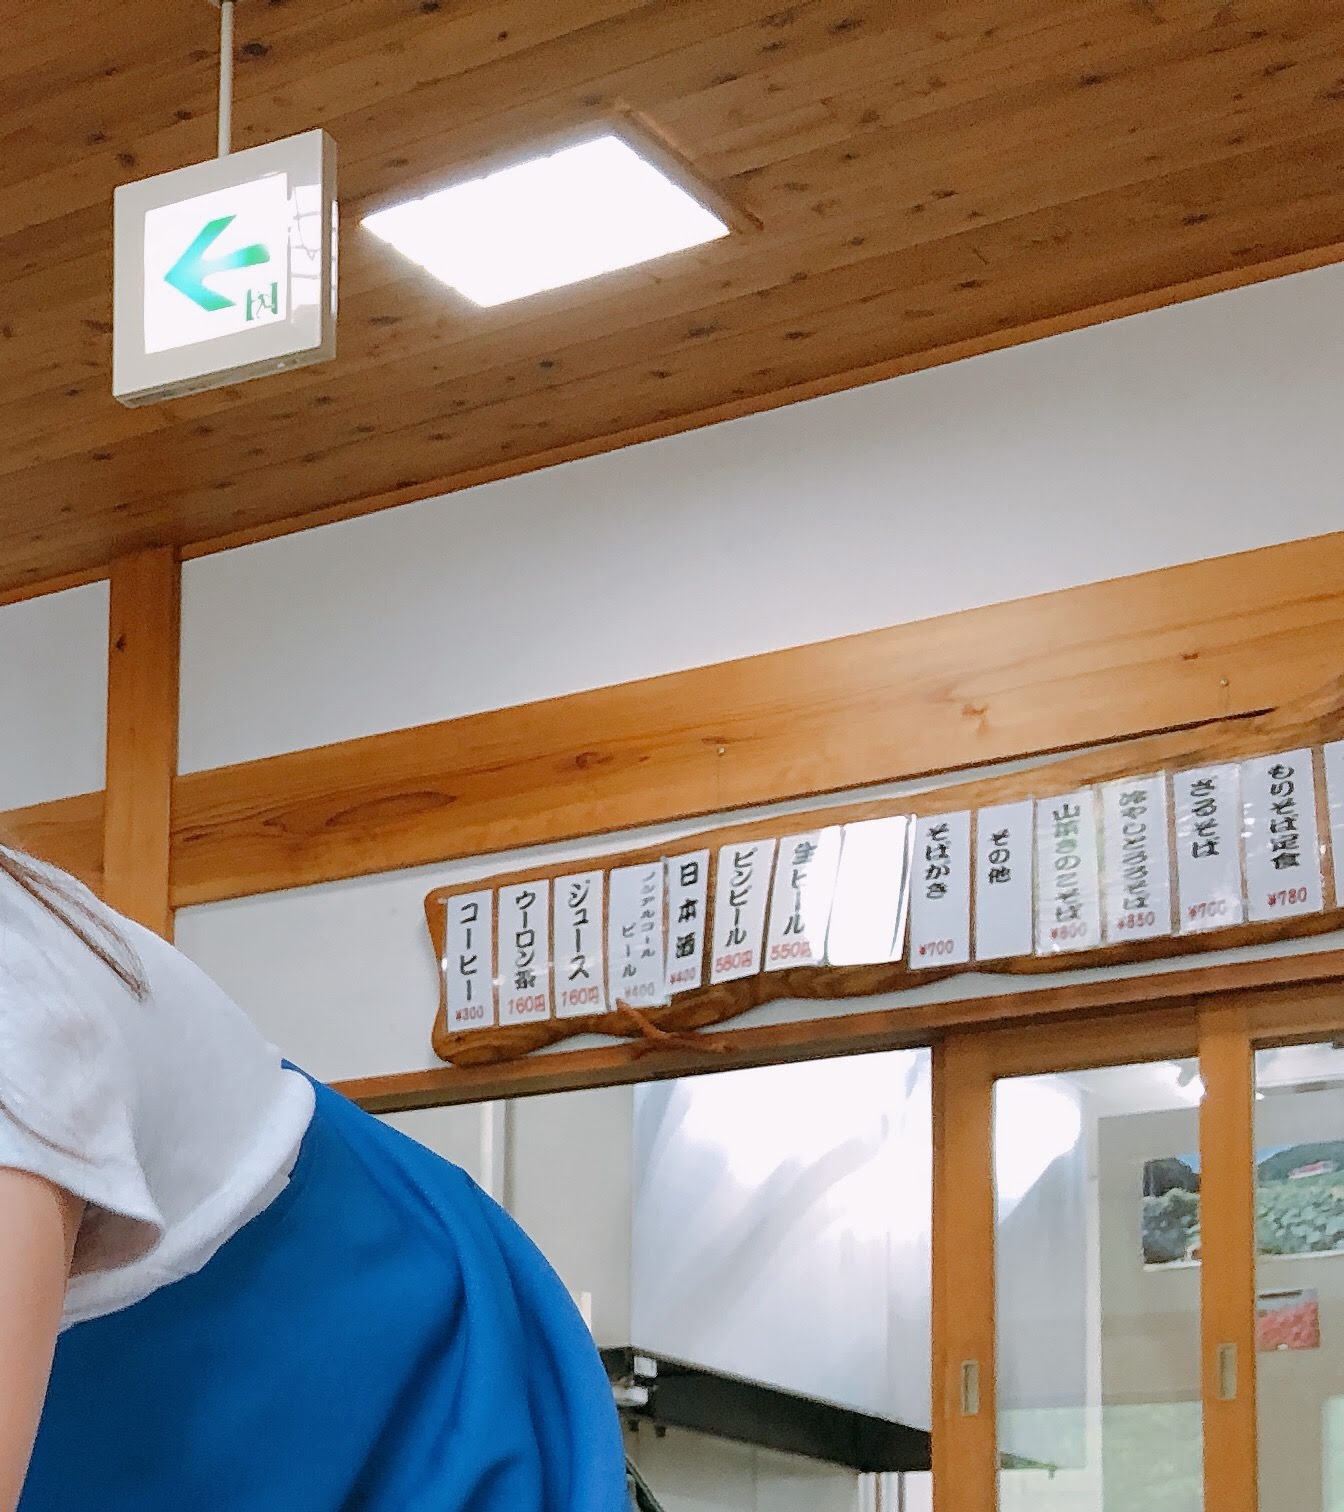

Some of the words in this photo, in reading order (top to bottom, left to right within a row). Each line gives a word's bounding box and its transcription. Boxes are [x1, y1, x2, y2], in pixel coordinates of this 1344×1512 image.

[1267, 763, 1300, 870] もりそば定食
[988, 828, 1012, 884] その他
[676, 861, 699, 958] 日本酒
[1266, 887, 1307, 907] ¥780
[459, 902, 479, 1001] コーヒー
[514, 891, 537, 991] ウーロン茶
[567, 882, 590, 981] ジュース
[622, 922, 636, 978] ビール
[919, 939, 955, 956] ¥700
[715, 950, 753, 973] 580円
[455, 1005, 484, 1021] ¥300
[507, 993, 546, 1015] 160円
[561, 985, 599, 1008] 160円
